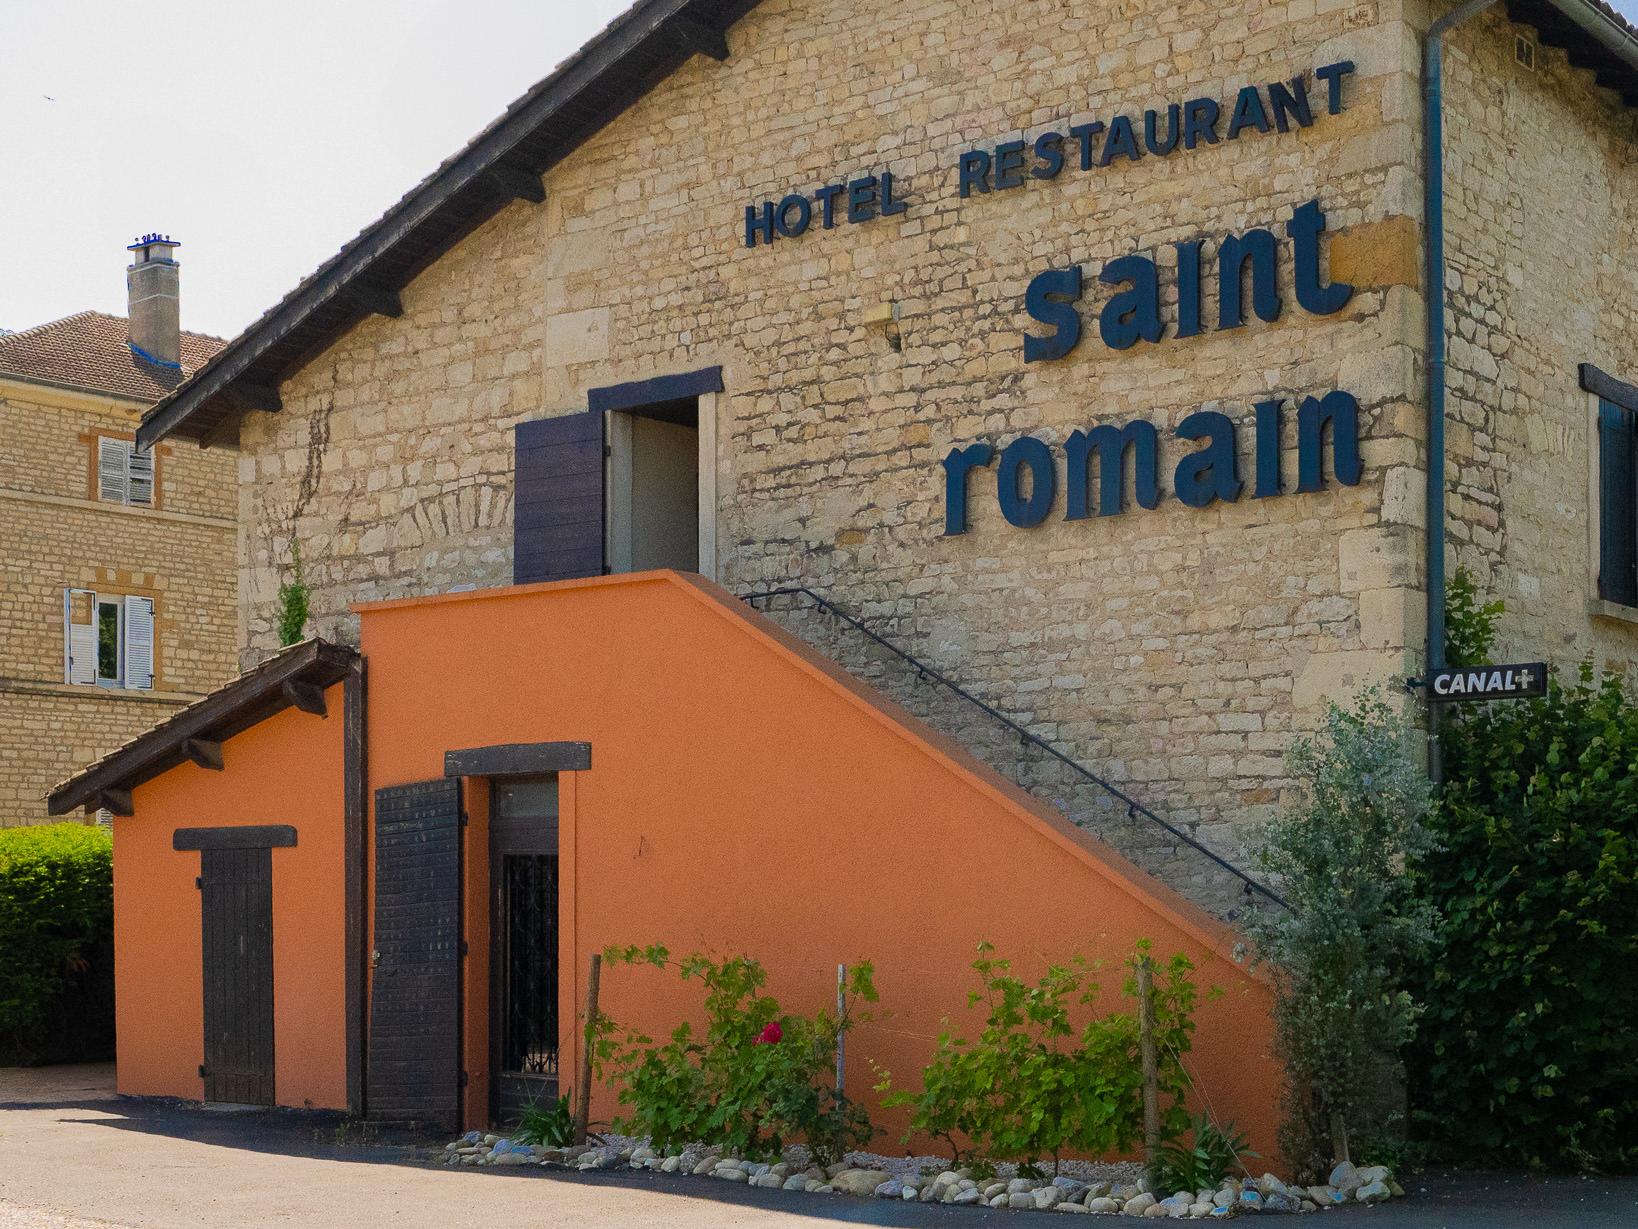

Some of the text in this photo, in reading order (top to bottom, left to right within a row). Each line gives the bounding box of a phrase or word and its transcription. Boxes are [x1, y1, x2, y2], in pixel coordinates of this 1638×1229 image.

[744, 61, 1356, 248] HOTEL RESTAURANT
[1023, 200, 1355, 363] saint
[942, 390, 1363, 537] romain
[1434, 669, 1534, 695] CANAL+
